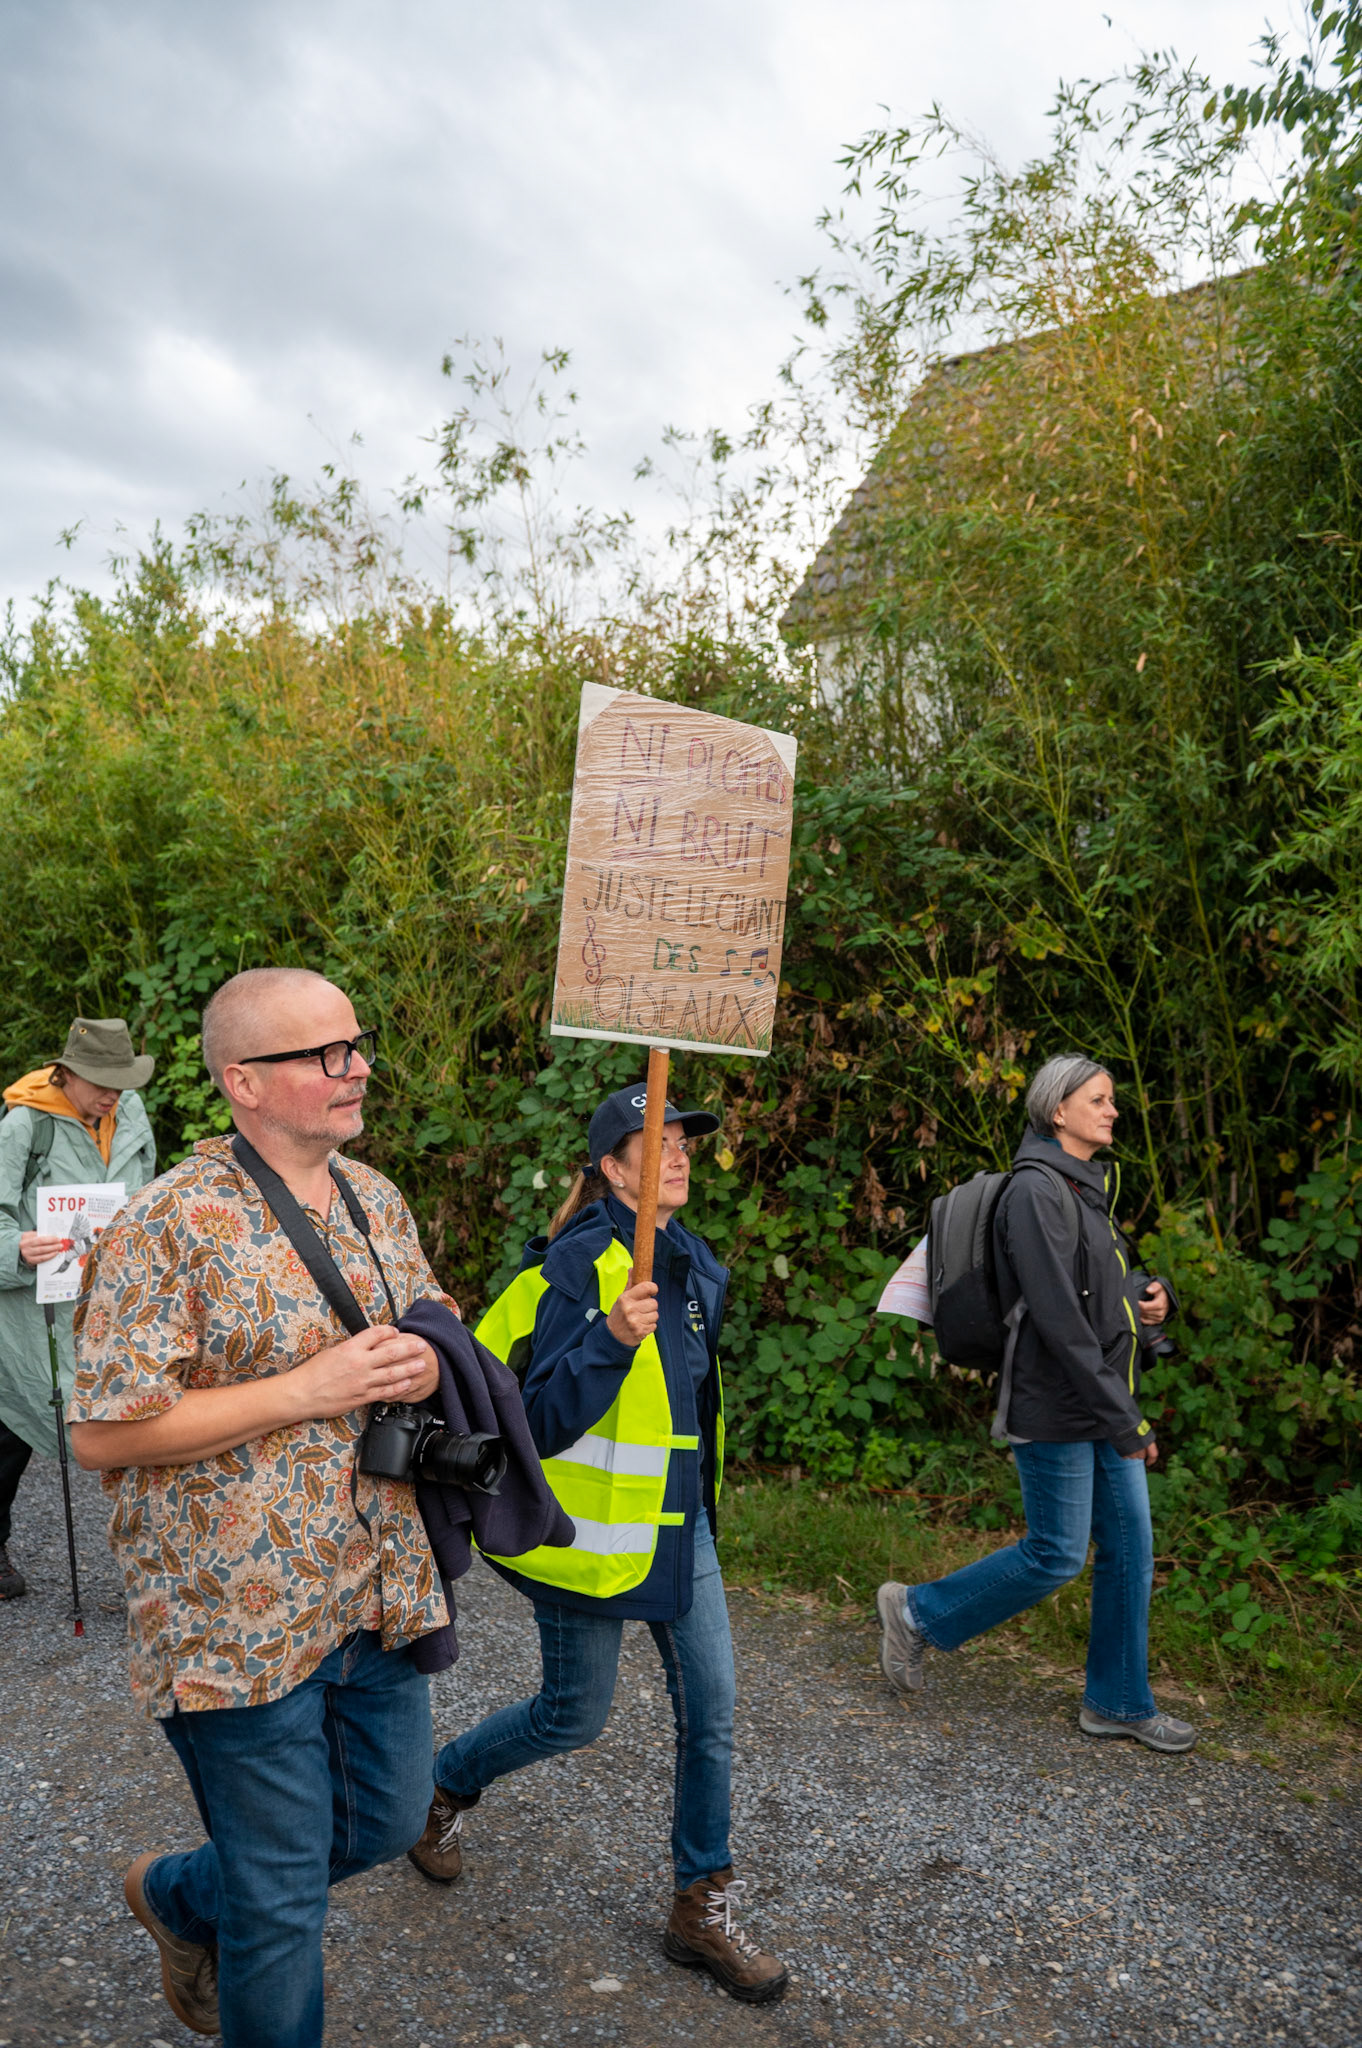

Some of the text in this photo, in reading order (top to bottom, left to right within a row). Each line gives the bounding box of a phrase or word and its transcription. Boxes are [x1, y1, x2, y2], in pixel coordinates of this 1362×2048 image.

[621, 718, 670, 776] NI
[613, 791, 784, 878] NI BRUIT
[581, 866, 679, 922] JUSTE
[715, 890, 787, 944] CHANT
[652, 937, 702, 974] DES
[593, 974, 756, 1045] OISEAUX
[47, 1196, 87, 1213] STOP
